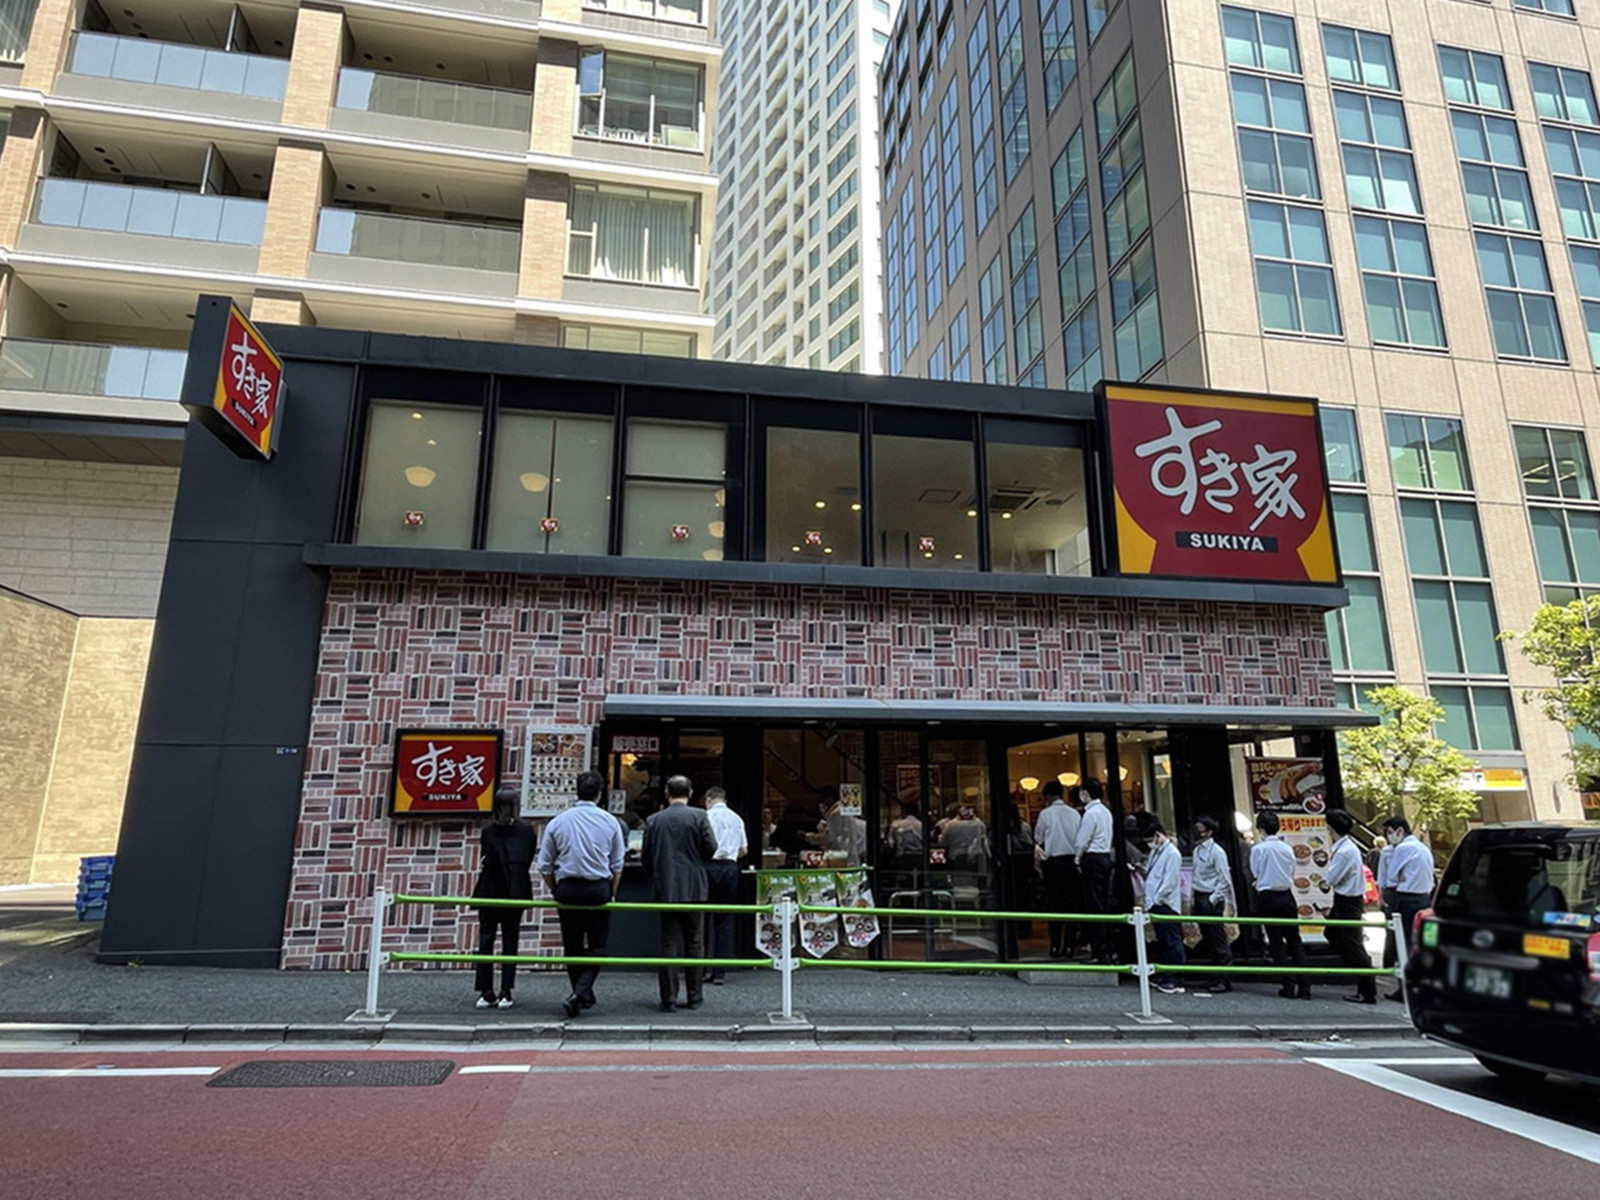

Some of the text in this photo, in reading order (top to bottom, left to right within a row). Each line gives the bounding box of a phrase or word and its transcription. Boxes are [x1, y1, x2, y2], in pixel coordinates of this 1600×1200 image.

[231, 331, 272, 419] すき家
[1134, 406, 1307, 532] すき家
[1190, 534, 1265, 551] SUKIYA
[411, 741, 486, 793] すき家
